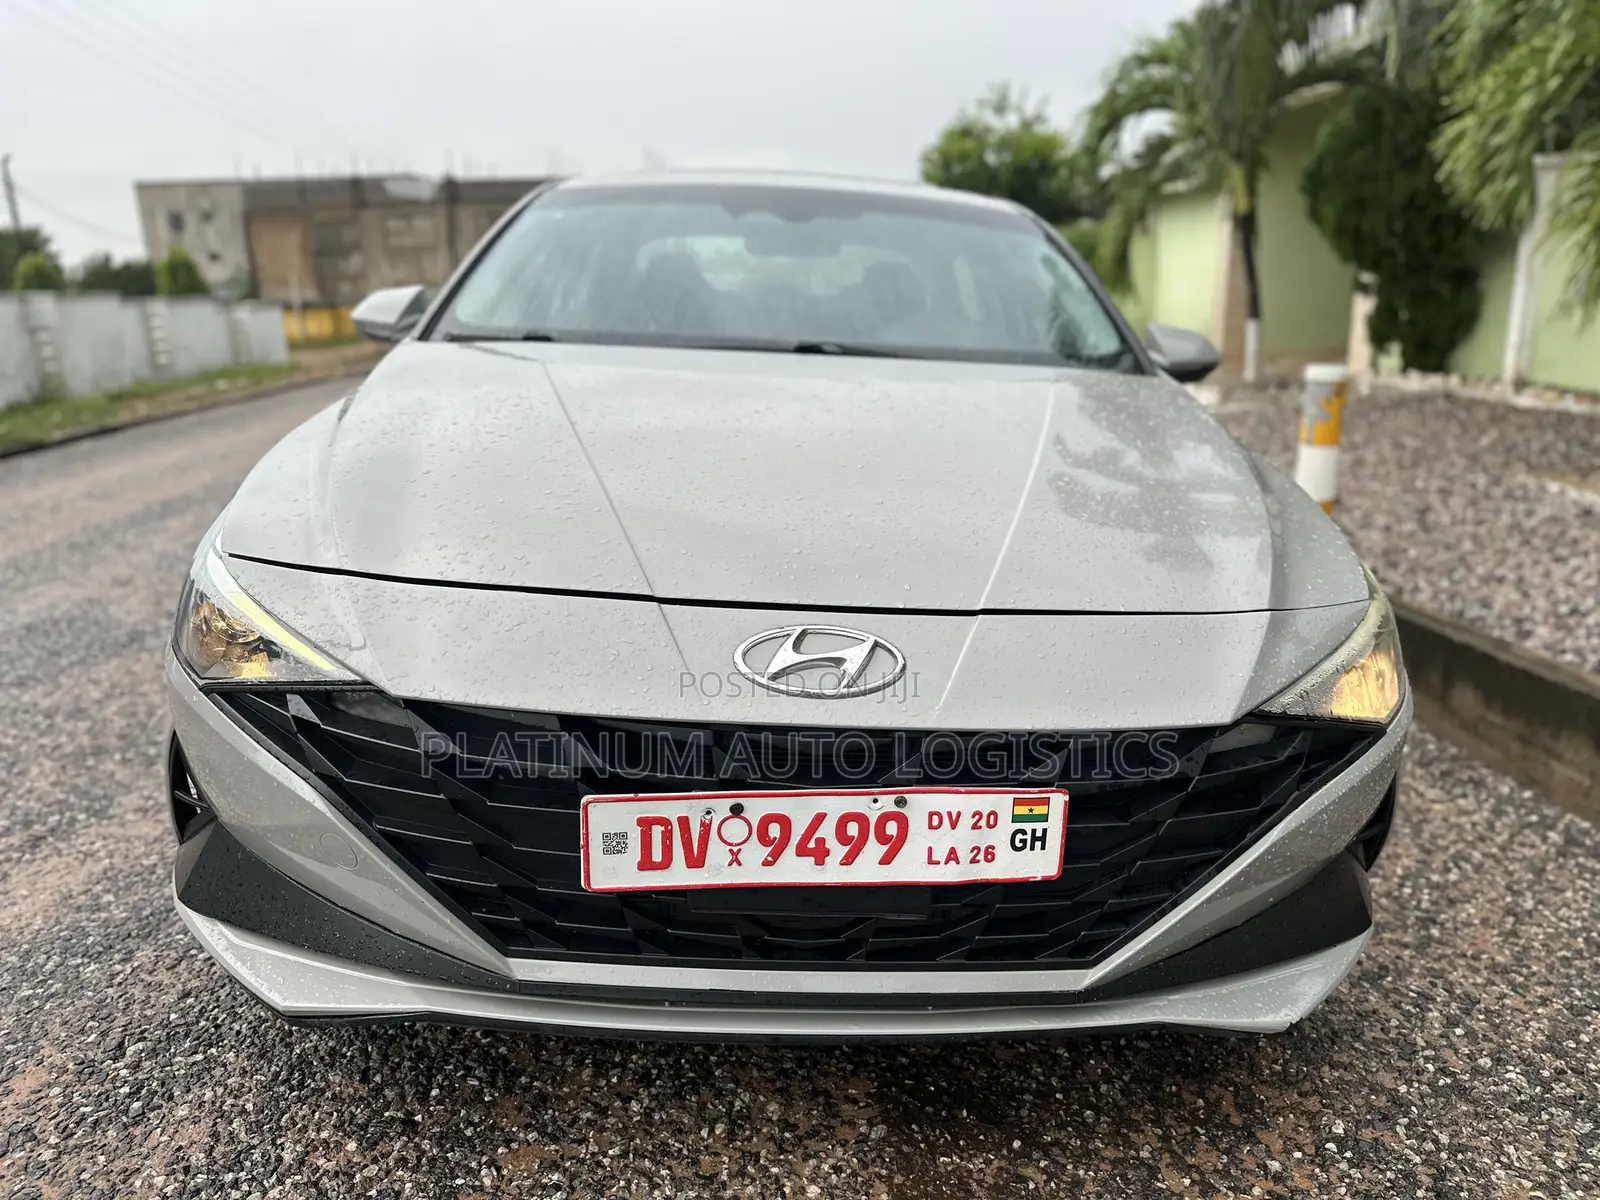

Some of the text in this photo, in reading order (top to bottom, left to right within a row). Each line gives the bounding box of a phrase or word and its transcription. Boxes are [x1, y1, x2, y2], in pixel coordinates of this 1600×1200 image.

[927, 810, 998, 830] DV 20
[636, 815, 712, 871] DV
[756, 811, 909, 867] 9499
[1009, 827, 1047, 852] GH
[926, 844, 996, 865] LA 26
